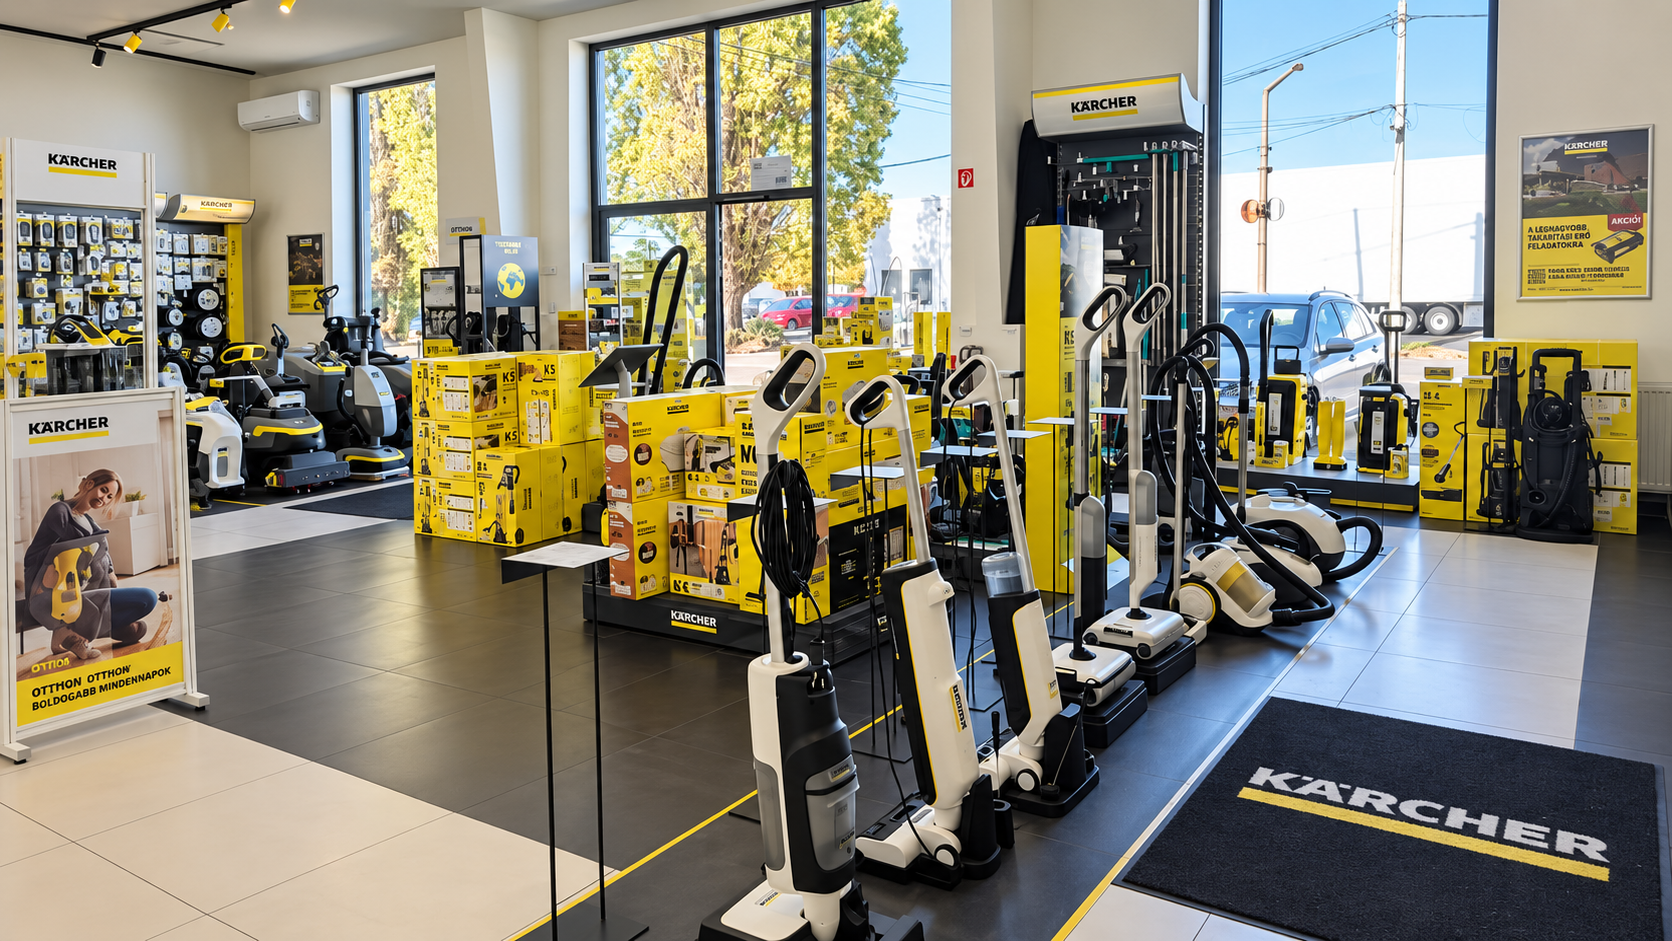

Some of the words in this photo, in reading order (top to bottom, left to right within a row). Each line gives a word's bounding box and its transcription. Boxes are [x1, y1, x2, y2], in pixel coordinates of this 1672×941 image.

[1071, 95, 1137, 113] KÄRCHER
[48, 153, 117, 170] KÄRCHER
[28, 416, 109, 435] KÄRCHER
[31, 677, 82, 698] OTTHON
[32, 686, 97, 711] BOLDOGABB
[99, 667, 172, 693] MINDENNAPOK
[1248, 766, 1610, 863] KÄRCHER
